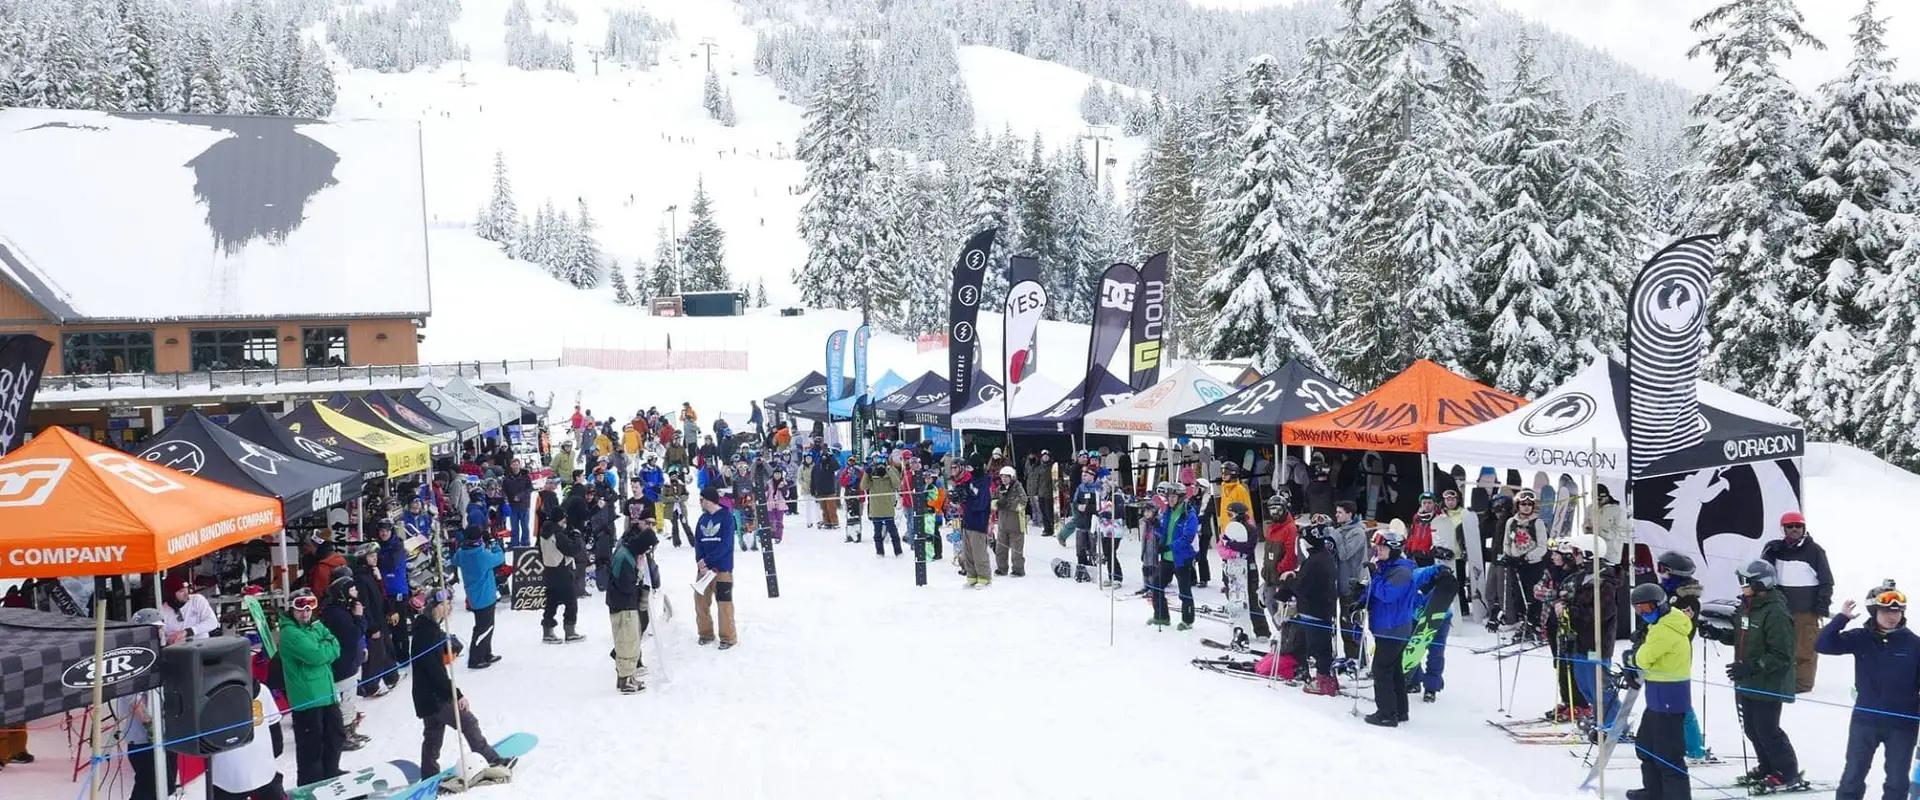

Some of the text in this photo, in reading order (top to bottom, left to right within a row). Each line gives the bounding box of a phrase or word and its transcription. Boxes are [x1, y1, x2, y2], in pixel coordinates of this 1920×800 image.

[1008, 291, 1044, 318] YES.
[1101, 278, 1137, 312] DC
[957, 355, 965, 392] ELECTRIC
[915, 413, 938, 424] ELECTRIC
[1353, 431, 1384, 444] WILL
[1387, 434, 1411, 446] DIE
[1737, 434, 1797, 457] DRAGON
[1542, 449, 1617, 471] DRAGON
[167, 509, 274, 555] UNION BINDING COMPANY
[8, 545, 127, 566] COMPANY
[516, 586, 547, 597] FREE
